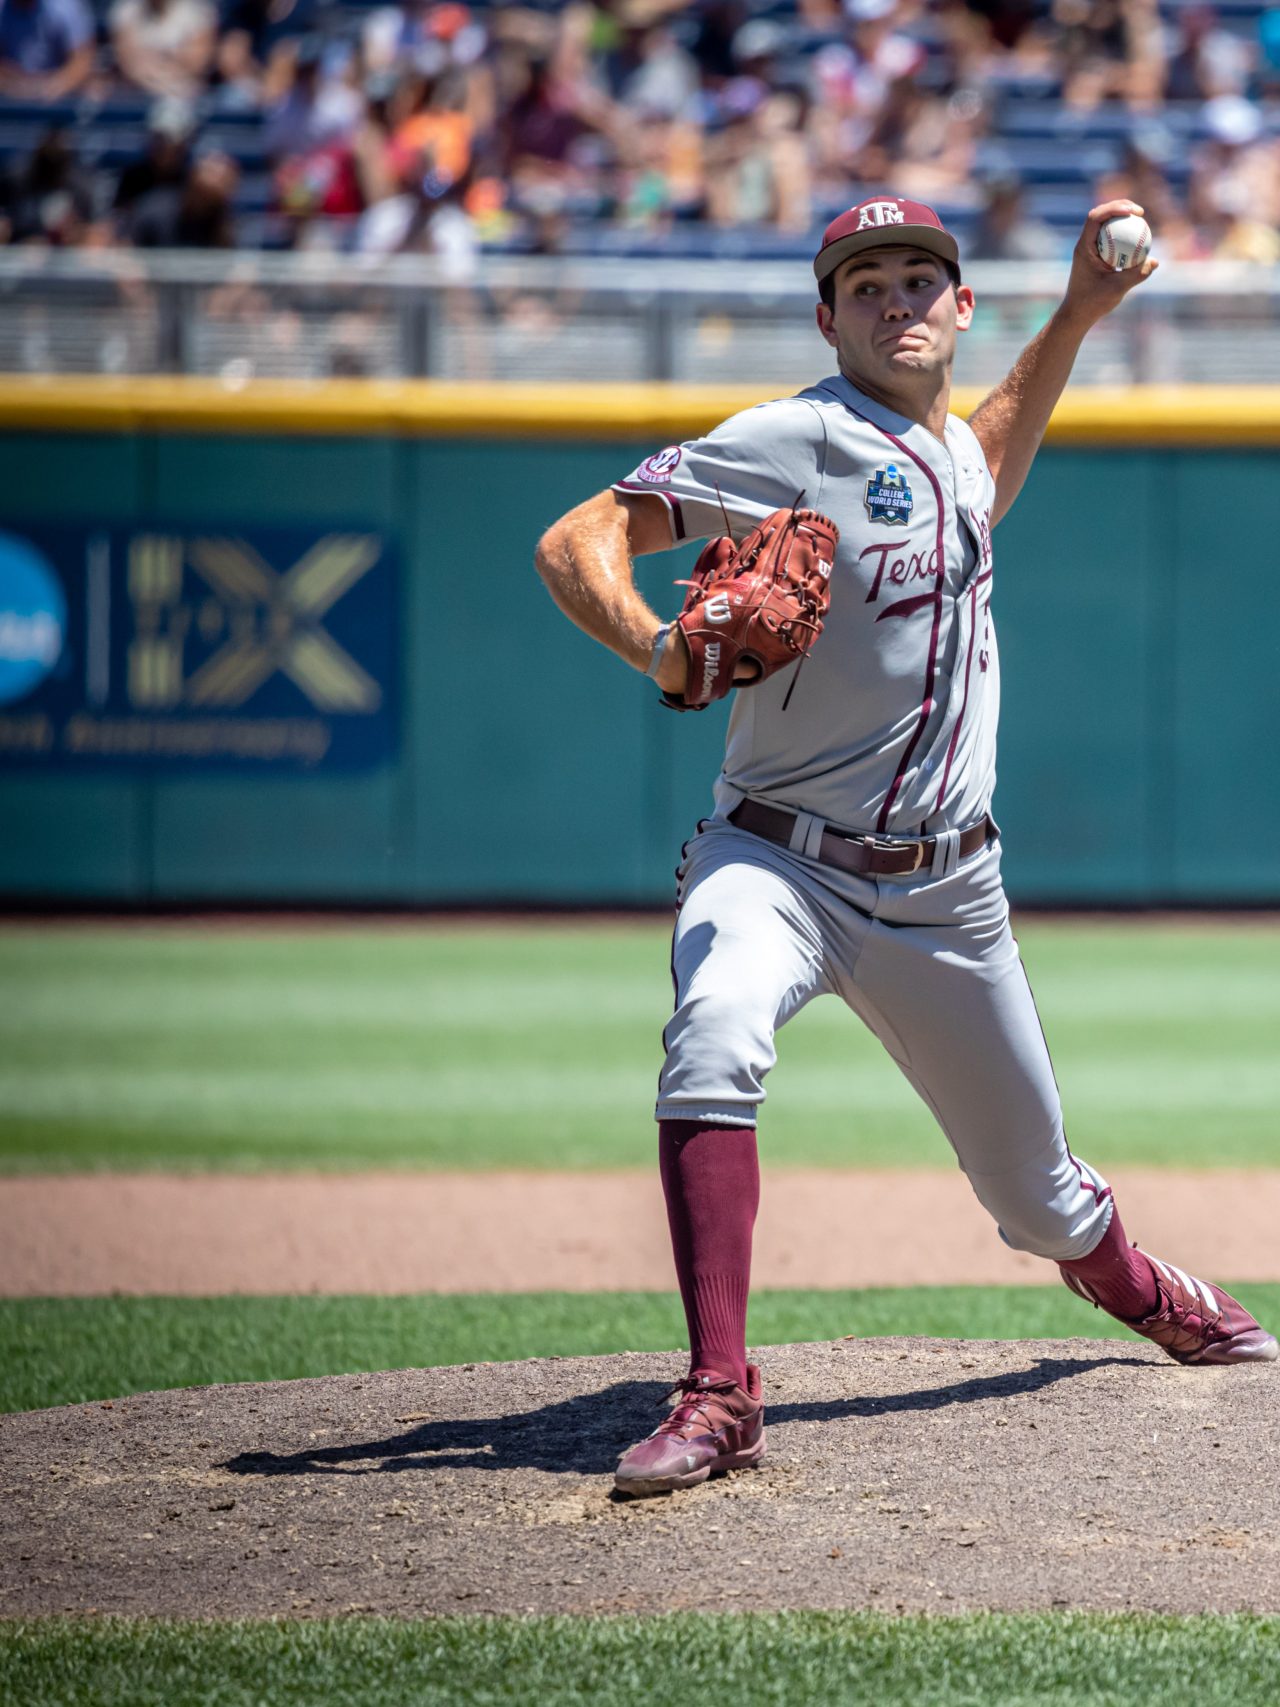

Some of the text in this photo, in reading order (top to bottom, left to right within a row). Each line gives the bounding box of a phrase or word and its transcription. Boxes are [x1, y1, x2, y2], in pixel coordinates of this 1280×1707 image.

[878, 488, 905, 499] COLLEGE
[868, 495, 891, 506] WORLD
[892, 498, 912, 509] SERIES
[701, 642, 720, 698] Wilson
